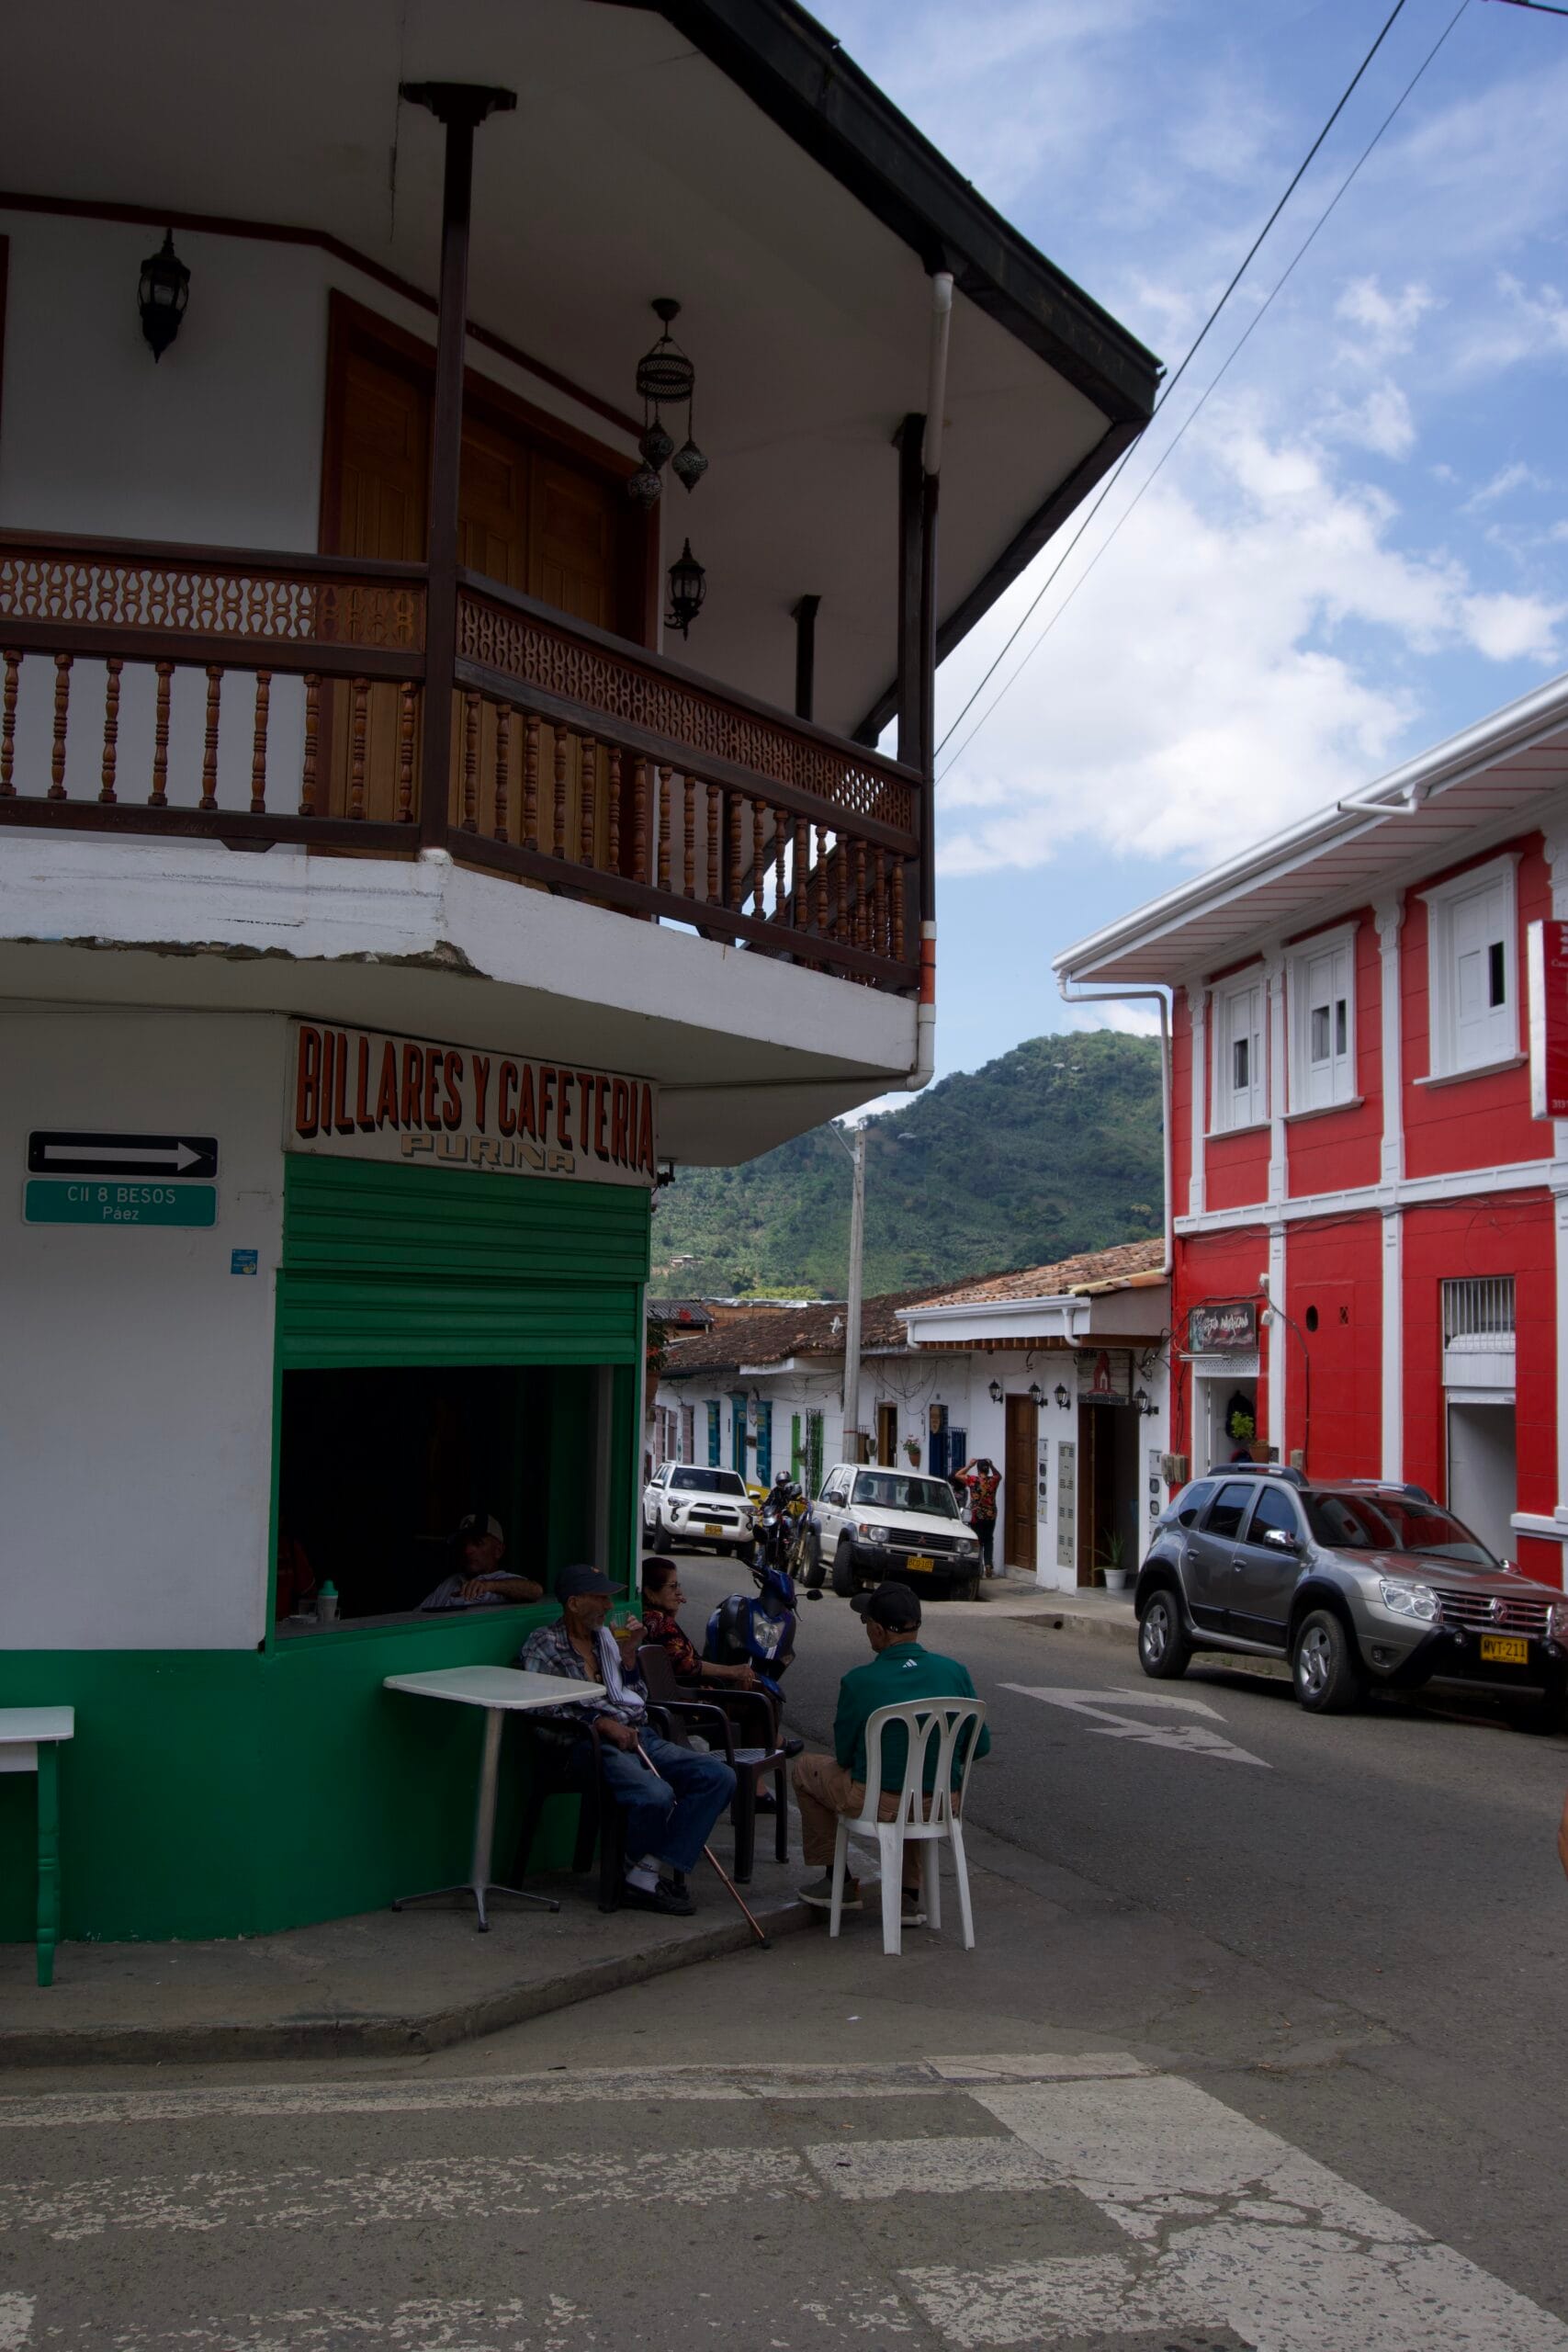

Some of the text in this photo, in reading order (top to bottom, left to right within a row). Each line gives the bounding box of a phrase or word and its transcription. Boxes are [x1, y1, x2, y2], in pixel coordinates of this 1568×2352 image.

[296, 1025, 655, 1179] BILLARES Y CAFETERIA
[401, 1134, 575, 1174] PURINA
[97, 1186, 108, 1203] 8
[117, 1187, 176, 1204] BESOS
[102, 1205, 140, 1220] Páez
